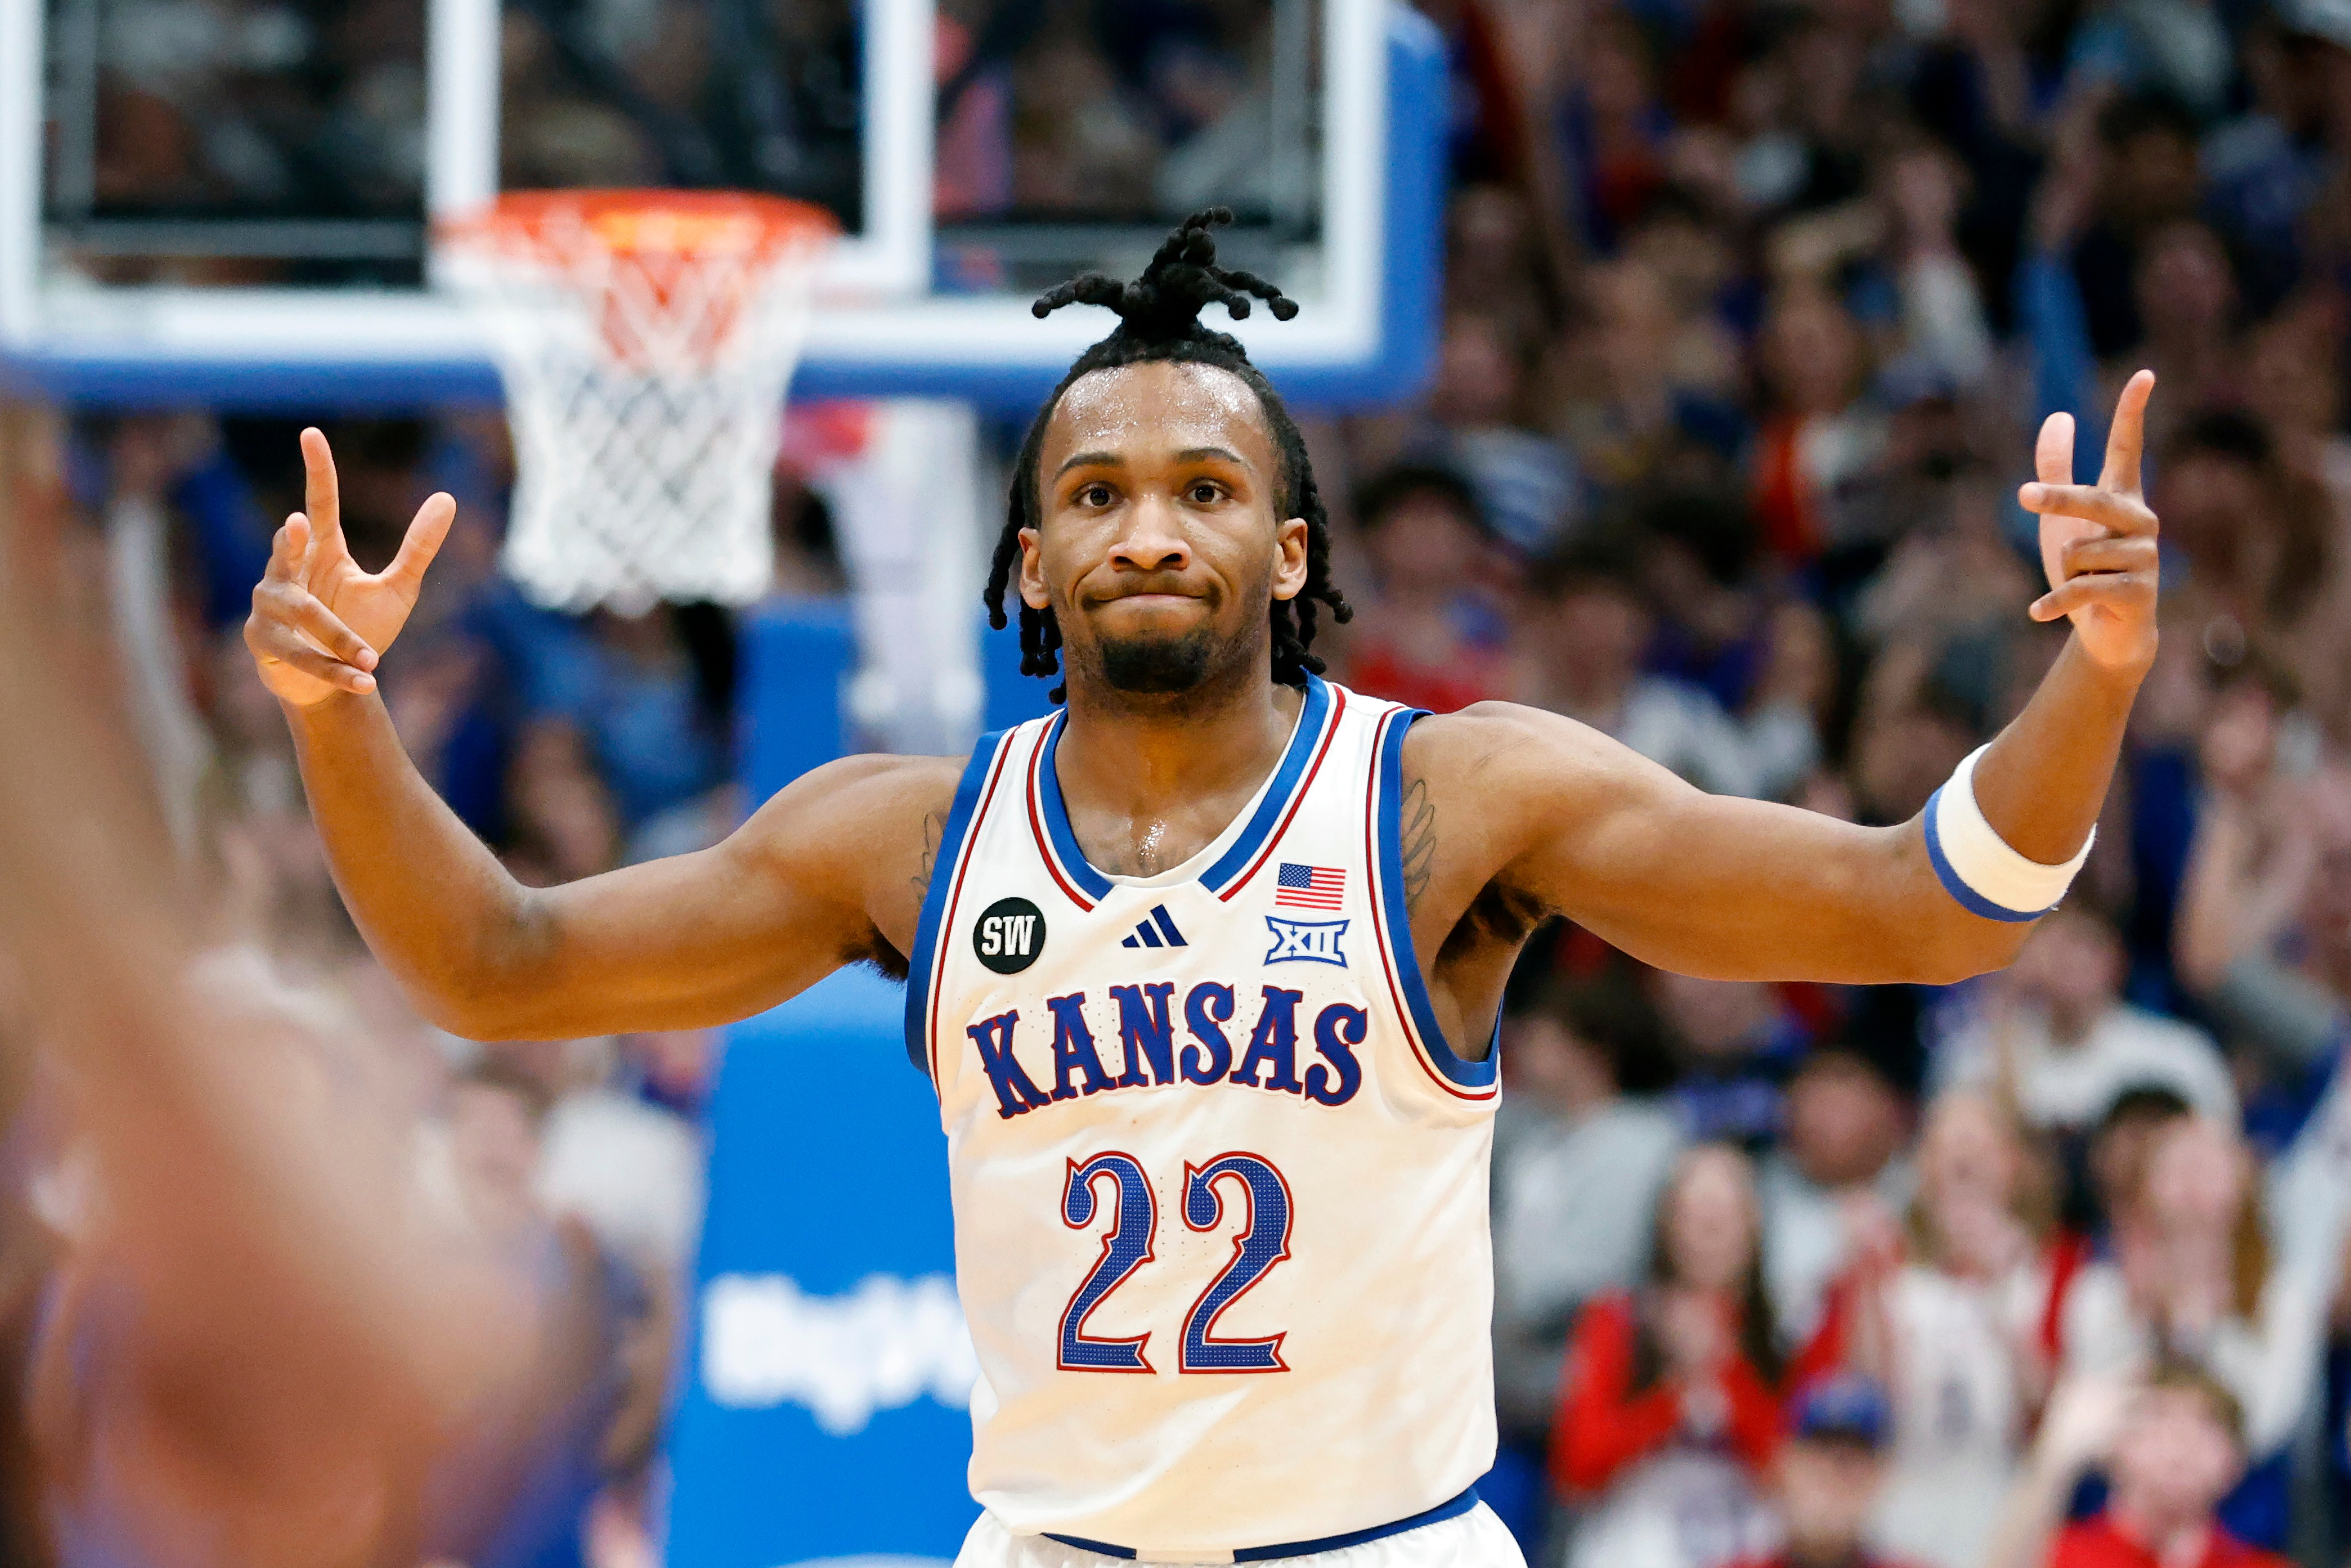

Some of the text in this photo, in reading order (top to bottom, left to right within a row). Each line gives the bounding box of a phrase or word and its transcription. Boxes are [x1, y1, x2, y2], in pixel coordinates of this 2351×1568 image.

[981, 914, 1037, 956] SW
[1268, 919, 1346, 963] XII
[967, 981, 1368, 1120] KANSAS
[1057, 1150, 1294, 1374] 22
